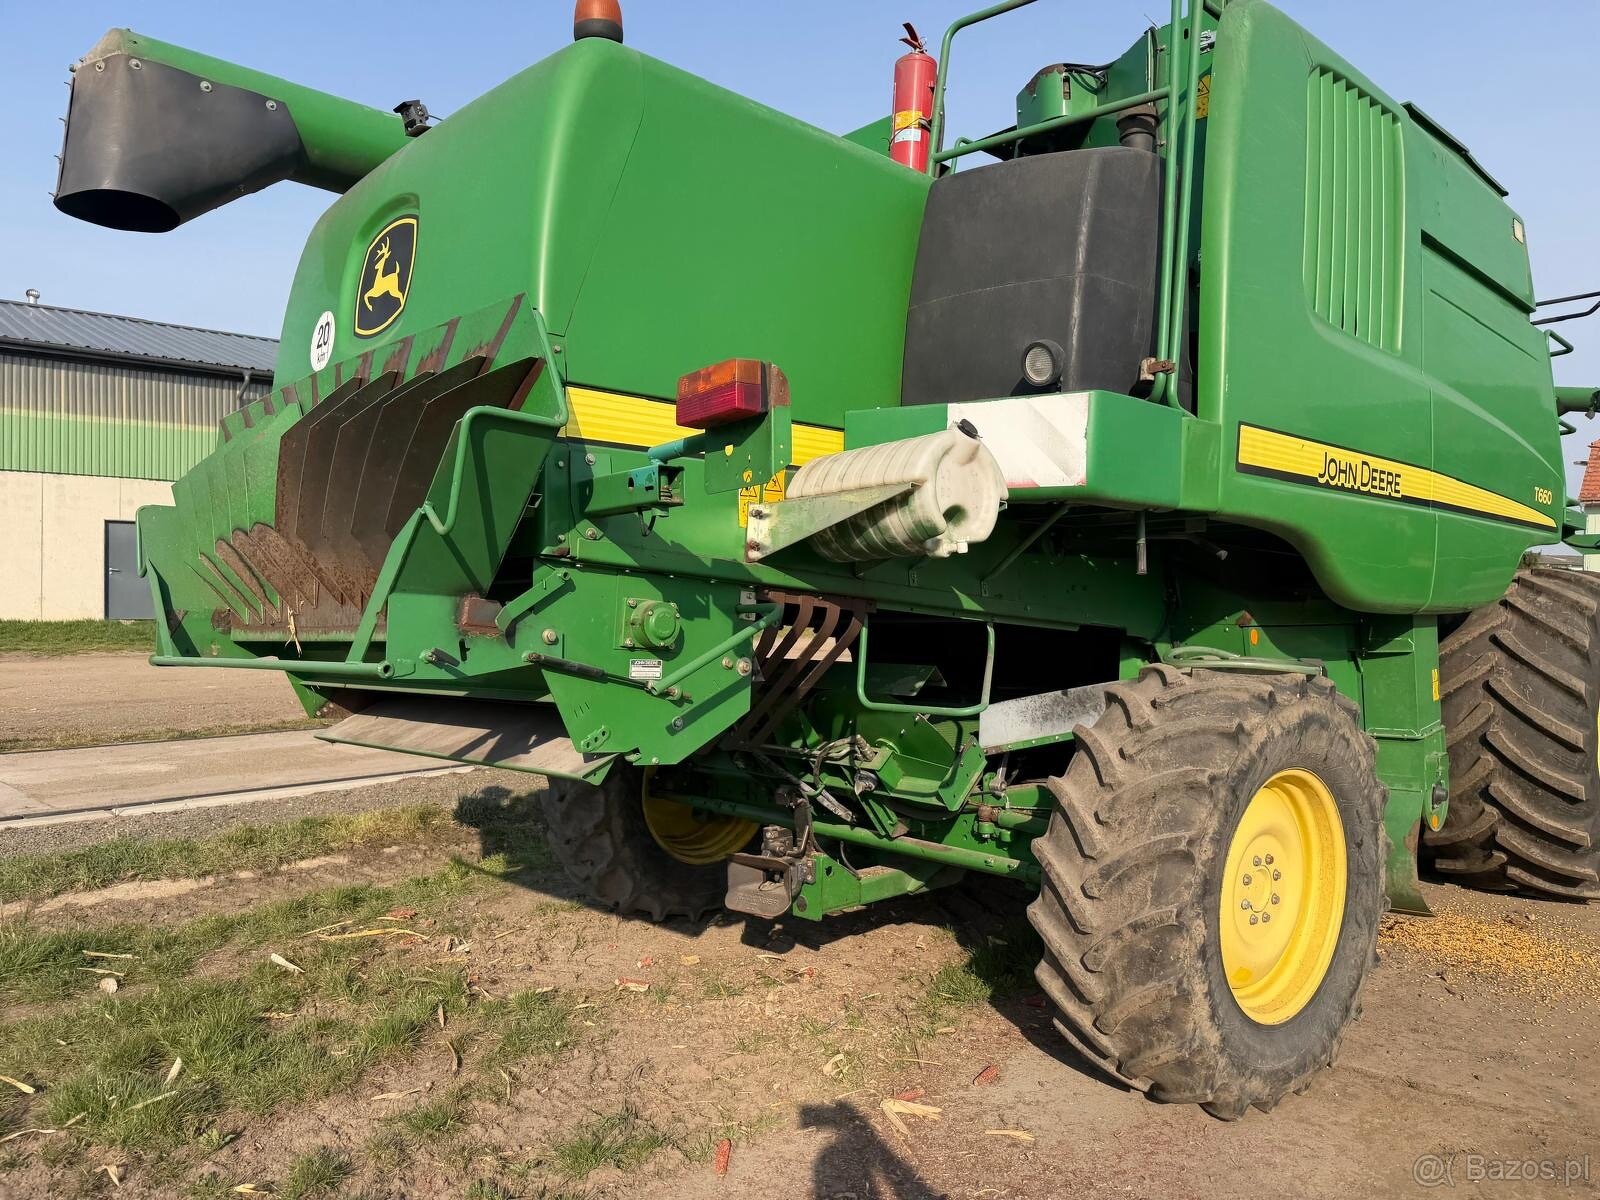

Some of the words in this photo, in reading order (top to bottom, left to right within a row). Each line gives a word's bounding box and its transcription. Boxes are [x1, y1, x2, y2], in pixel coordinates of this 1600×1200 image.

[316, 321, 330, 349] 20
[1318, 451, 1358, 486] JOHN
[1360, 460, 1401, 495] DEERE
[1534, 486, 1553, 505] T660
